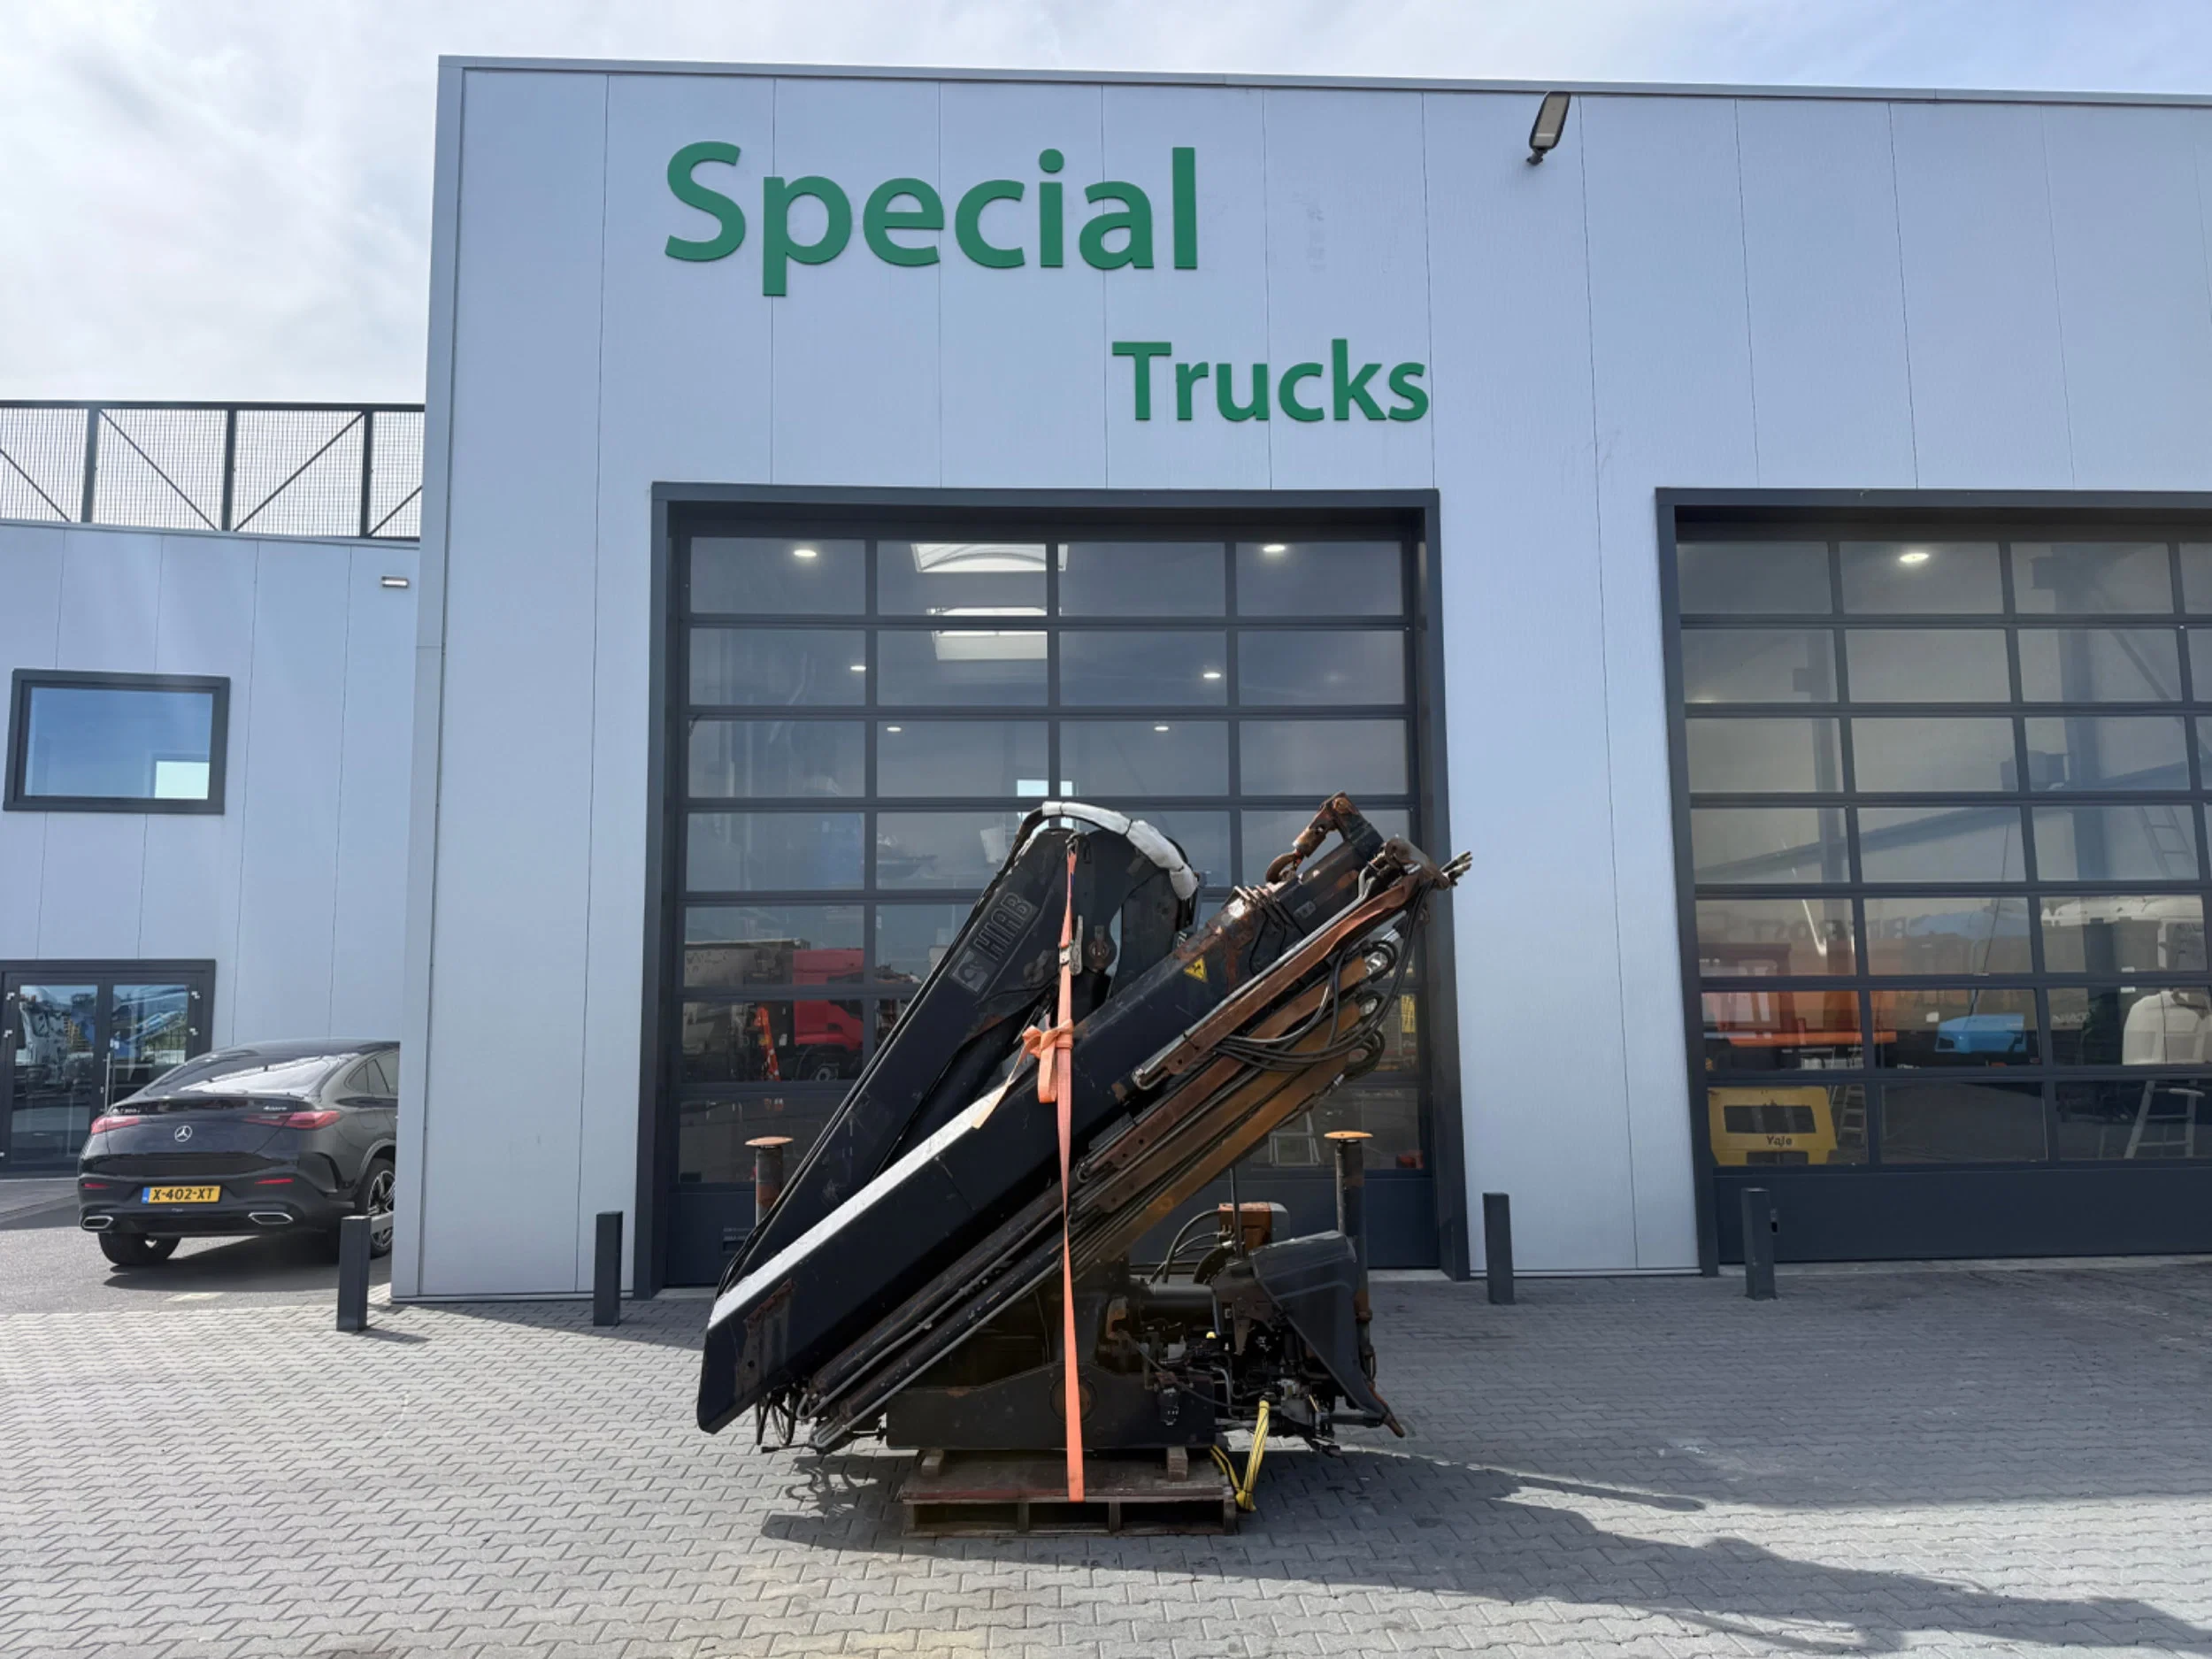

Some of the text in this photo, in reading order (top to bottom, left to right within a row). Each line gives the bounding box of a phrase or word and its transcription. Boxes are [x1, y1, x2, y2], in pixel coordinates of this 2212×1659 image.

[664, 141, 1198, 296] Special
[1111, 338, 1430, 423] Trucks
[973, 892, 1033, 961] HIAB
[152, 1187, 215, 1202] X-402-XT
